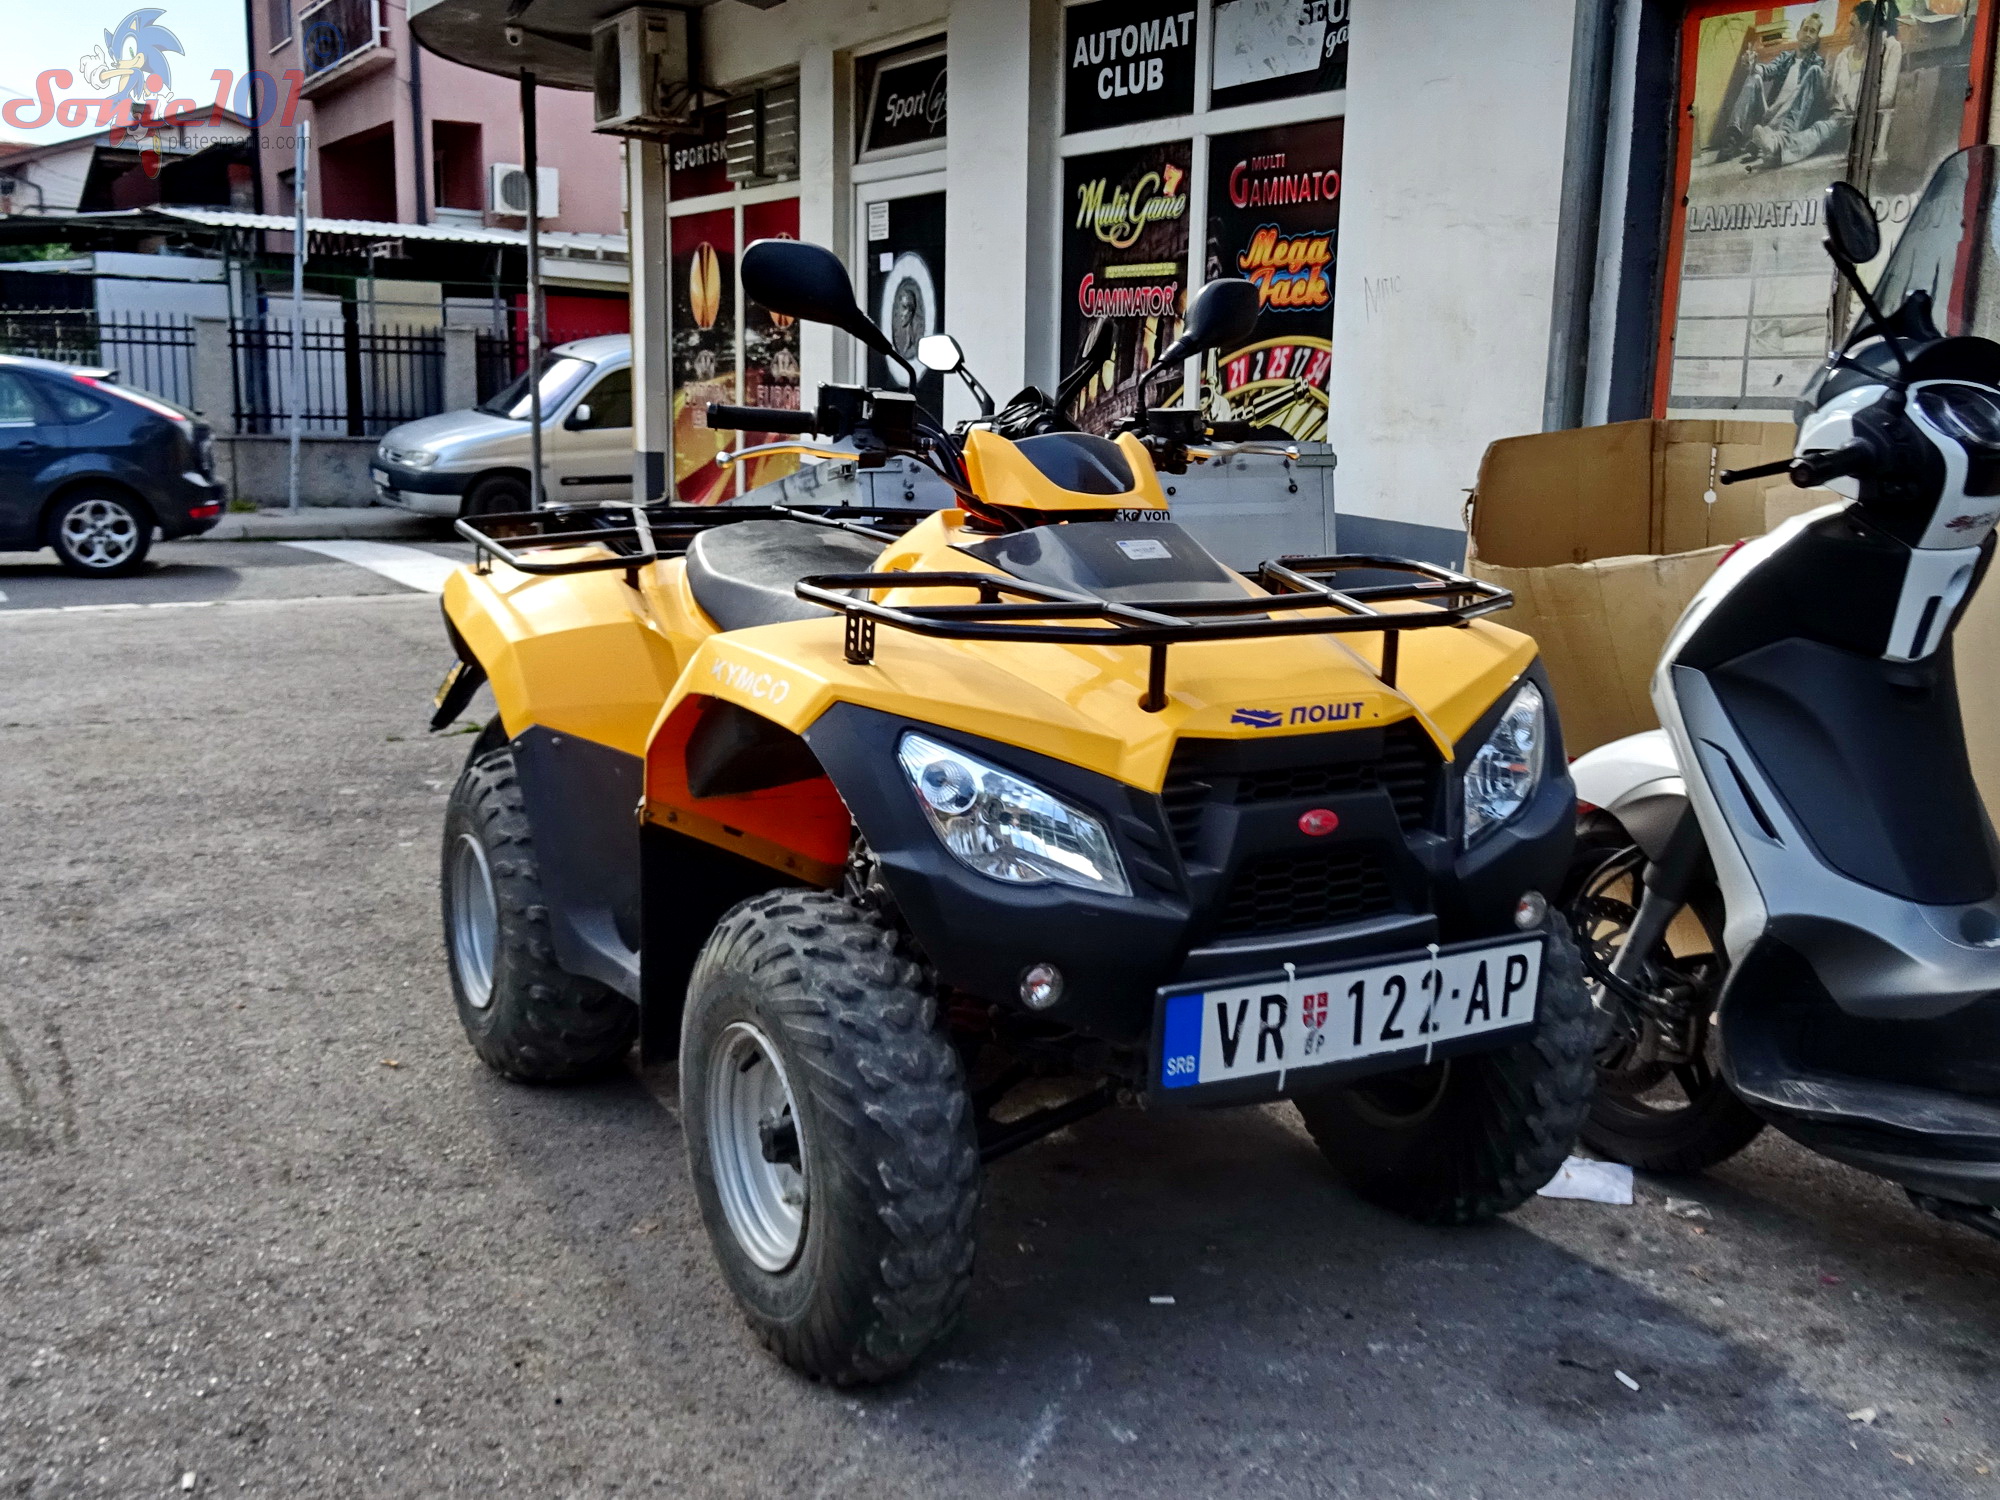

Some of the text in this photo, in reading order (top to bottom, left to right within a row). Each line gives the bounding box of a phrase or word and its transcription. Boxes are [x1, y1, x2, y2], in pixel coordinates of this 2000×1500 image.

[1073, 11, 1195, 68] AUTOMAT
[1098, 58, 1164, 100] CLUB
[884, 90, 927, 127] Sport
[1251, 153, 1286, 171] MULTI
[1689, 199, 1818, 232] LAMINATNI
[1239, 228, 1332, 274] Mega
[1249, 266, 1330, 308] Jack
[1229, 346, 1331, 391] 21 2 25 17 34
[711, 658, 790, 705] KYMCO
[1216, 992, 1289, 1069] VR
[1166, 1055, 1196, 1077] SRB
